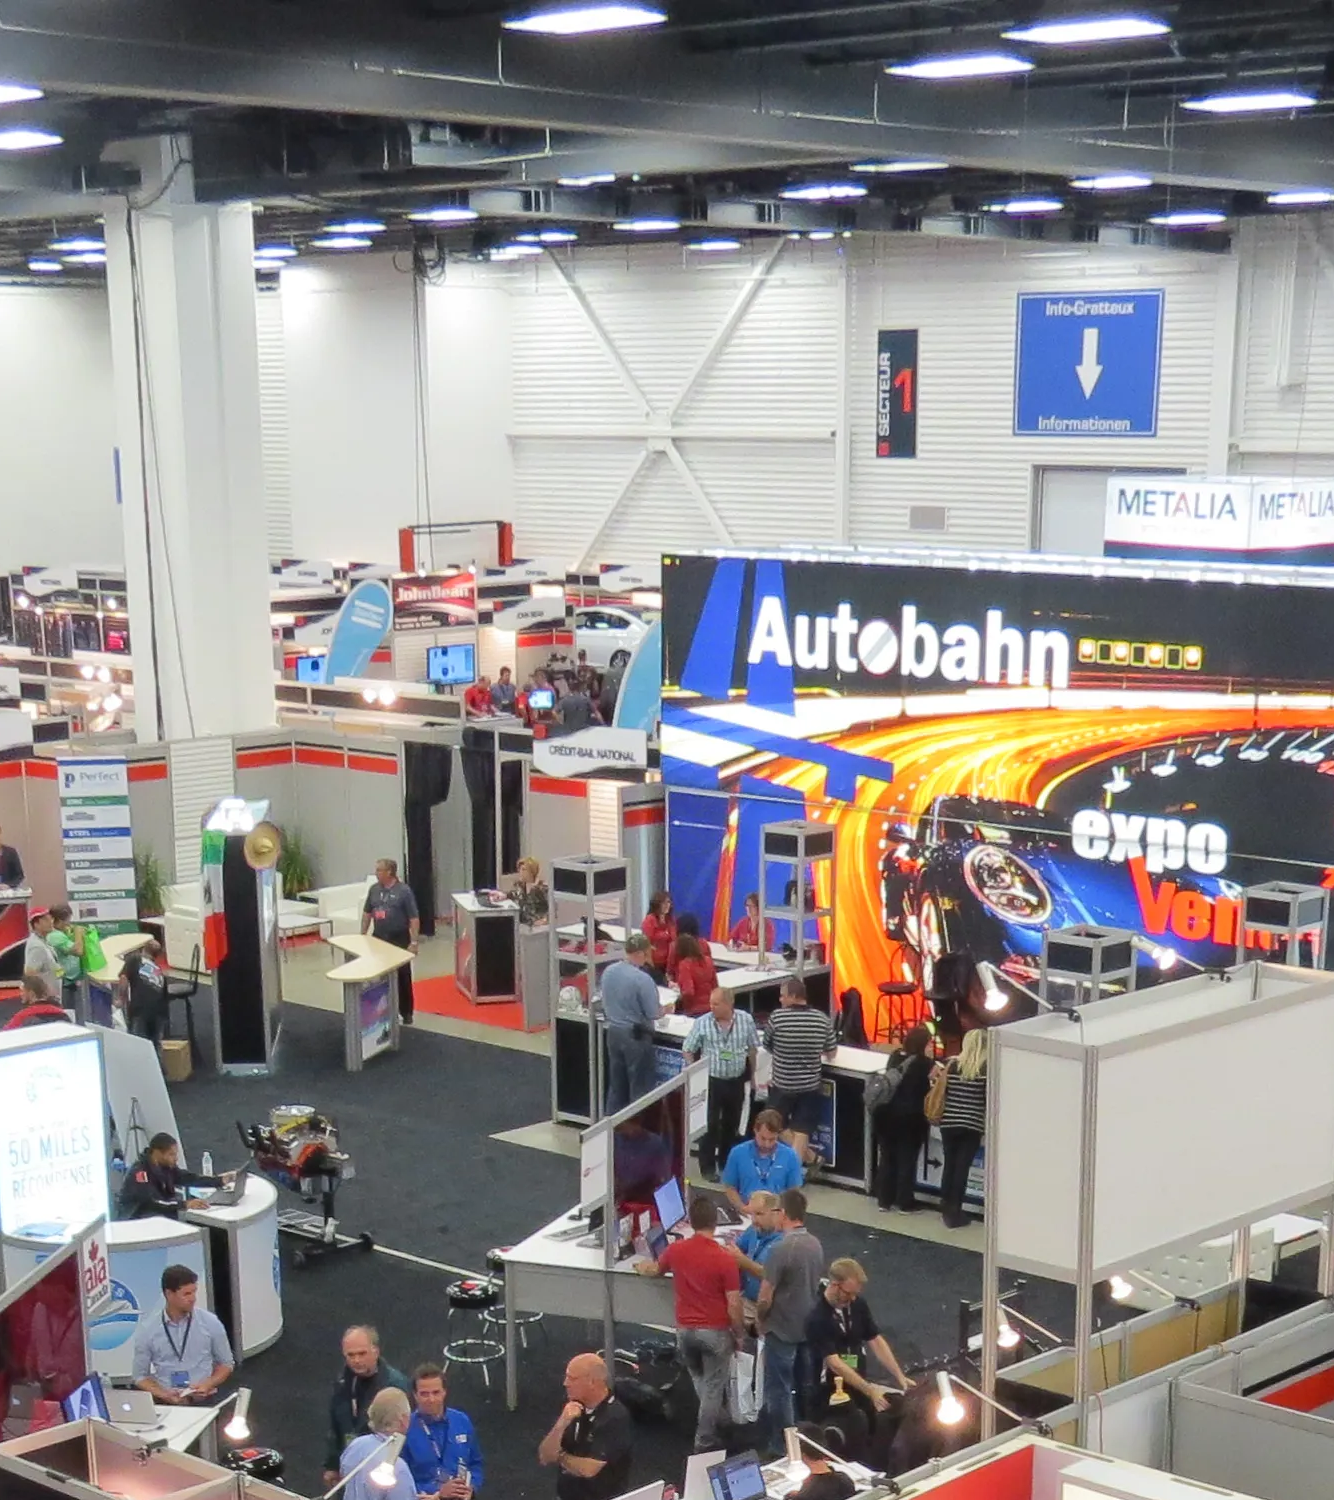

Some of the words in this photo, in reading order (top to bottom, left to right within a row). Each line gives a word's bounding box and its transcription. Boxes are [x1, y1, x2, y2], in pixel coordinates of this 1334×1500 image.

[877, 352, 891, 437] SECTEUR
[893, 367, 914, 413] 1
[1037, 415, 1131, 433] Informationen
[1116, 488, 1238, 521] METALIA
[748, 595, 1069, 689] Autobahn
[78, 770, 122, 784] Perfect
[600, 750, 637, 763] NATIONAL
[1071, 808, 1228, 875] expo
[8, 1138, 31, 1168] 50
[40, 1124, 92, 1161] MILES
